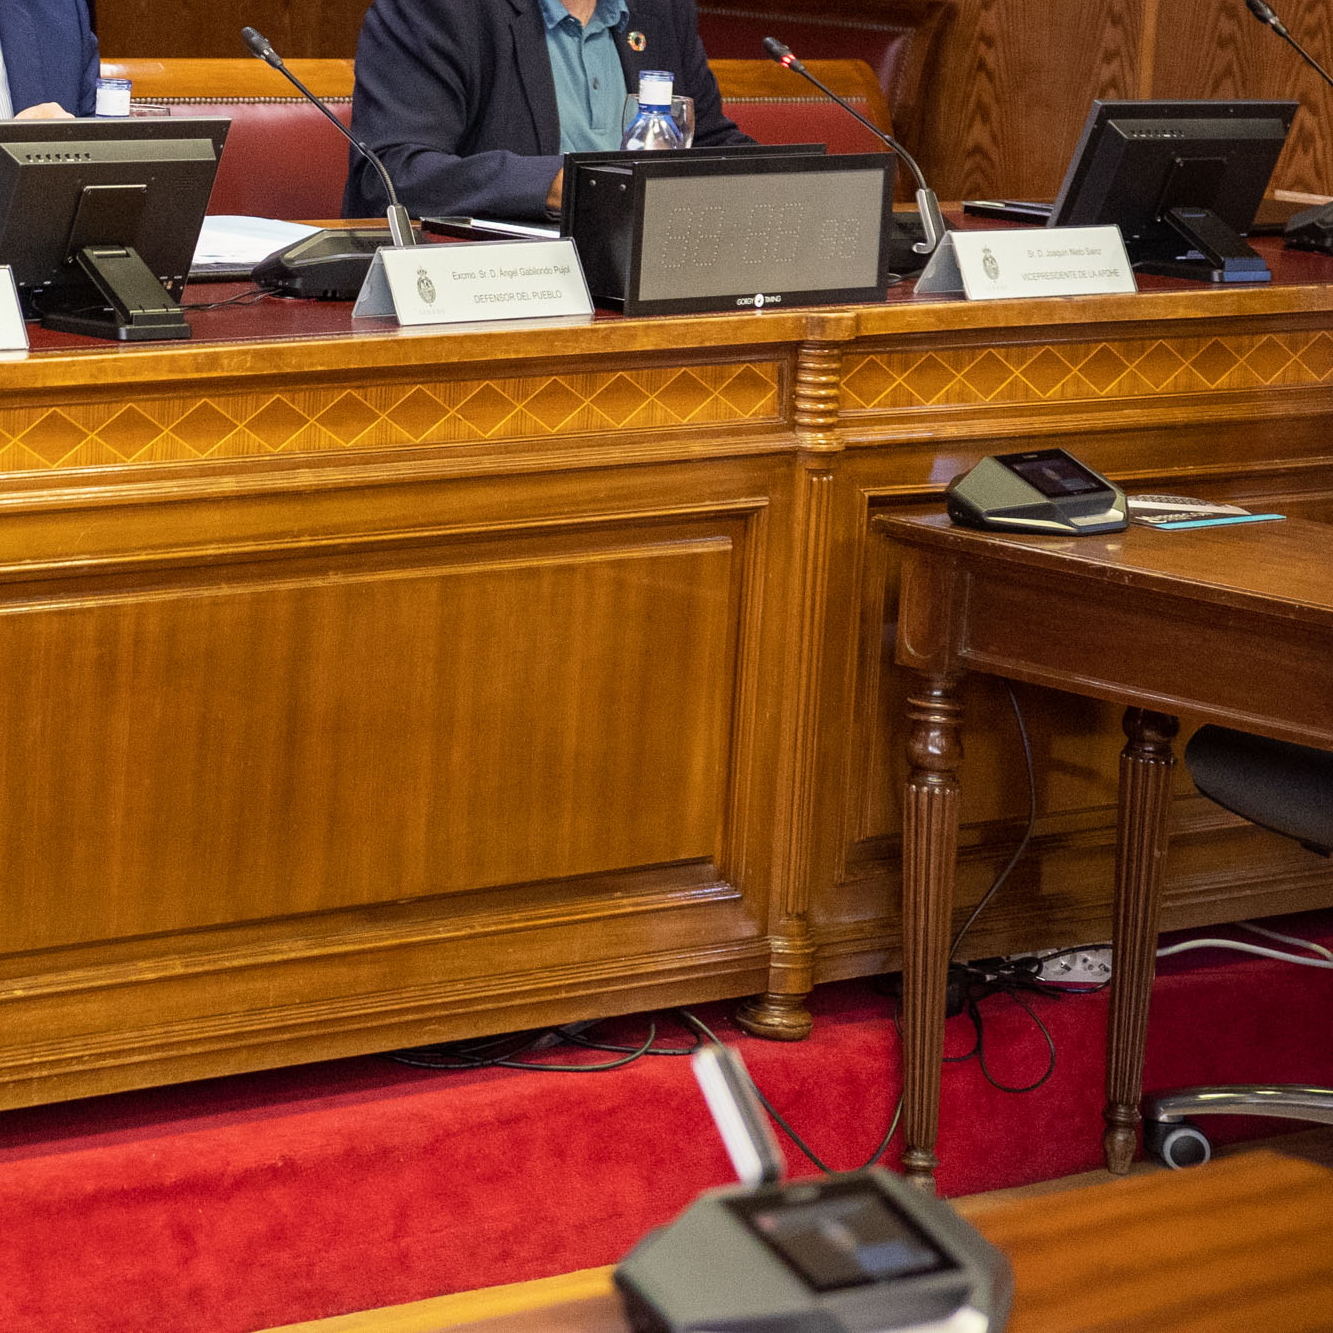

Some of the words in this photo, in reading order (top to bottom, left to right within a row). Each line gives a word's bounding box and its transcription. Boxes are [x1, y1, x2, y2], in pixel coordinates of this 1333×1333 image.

[473, 293, 514, 304] DEFENSOR
[516, 291, 531, 301] DEL
[532, 289, 562, 300] PUEBLO
